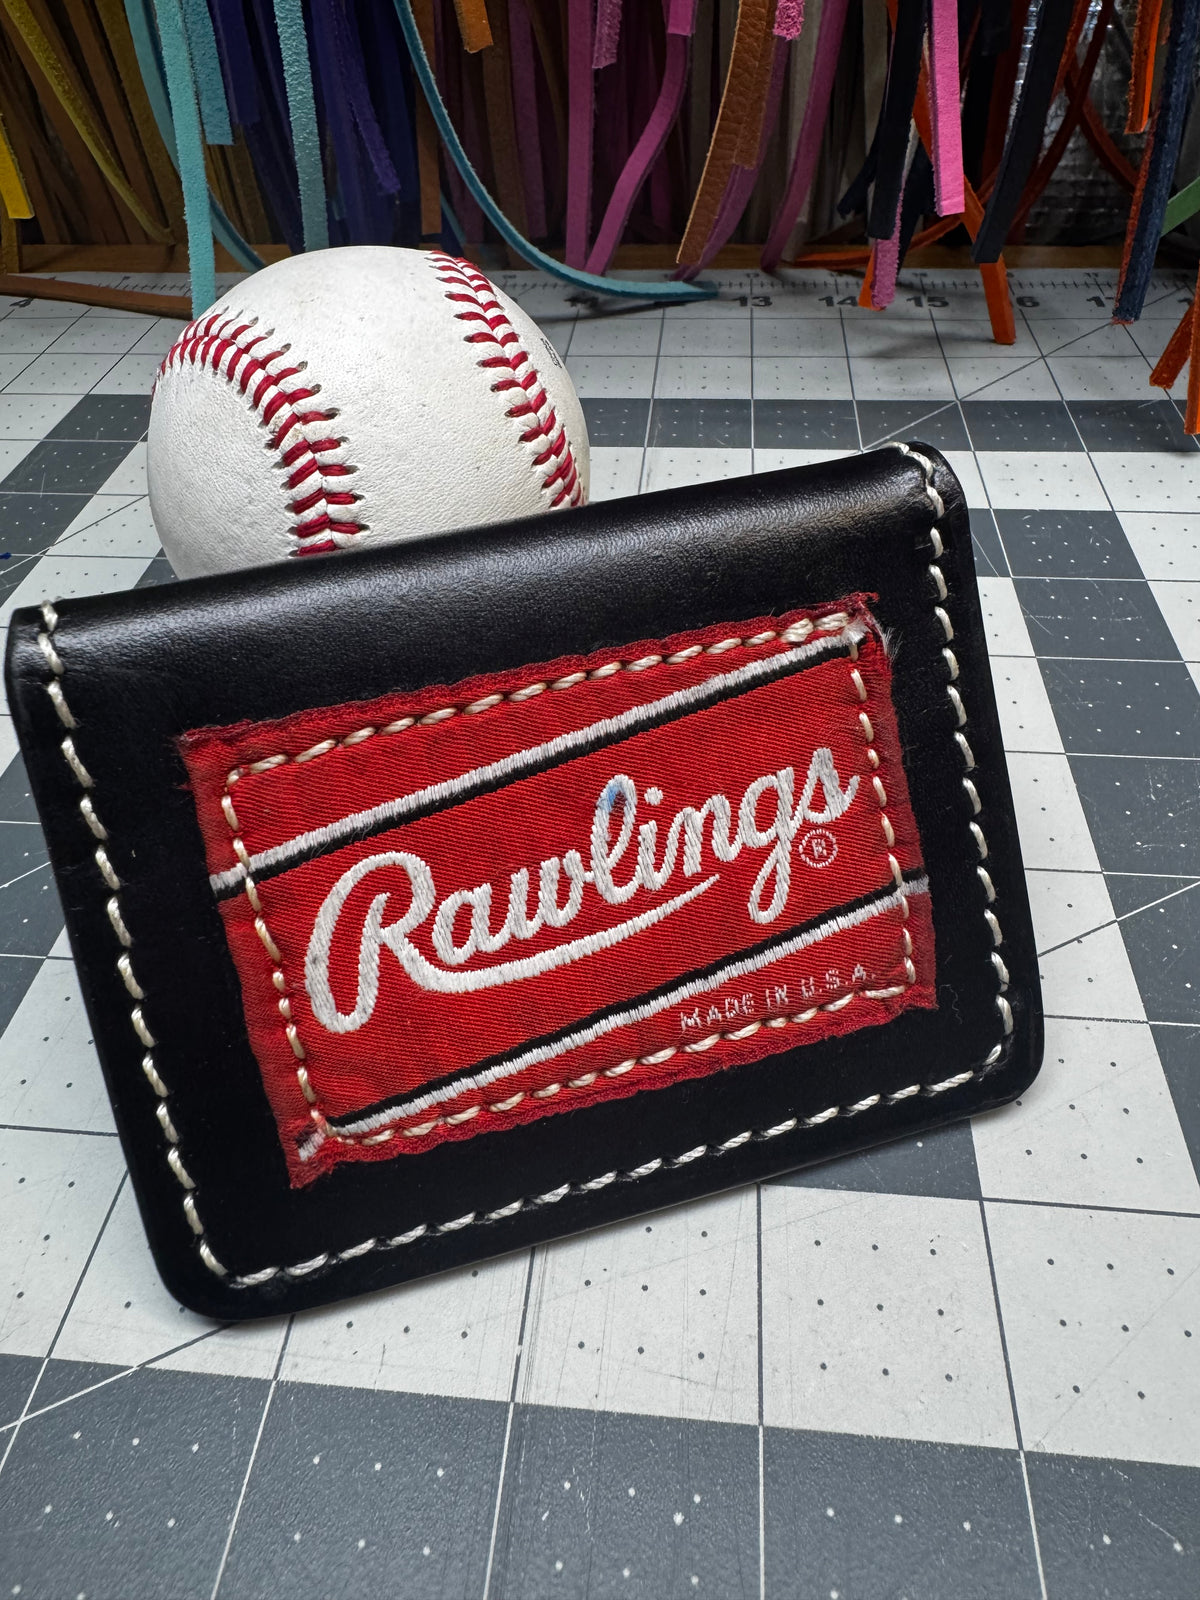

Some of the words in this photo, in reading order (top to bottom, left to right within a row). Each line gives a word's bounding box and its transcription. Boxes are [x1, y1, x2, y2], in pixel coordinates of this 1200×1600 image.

[734, 295, 773, 308] 13
[817, 295, 859, 308] 14
[906, 295, 950, 308] 15
[1009, 295, 1040, 308] 6
[1086, 296, 1114, 308] 1
[304, 747, 860, 1034] Rawlings
[679, 992, 755, 1031] MADE
[765, 984, 789, 1010] IN
